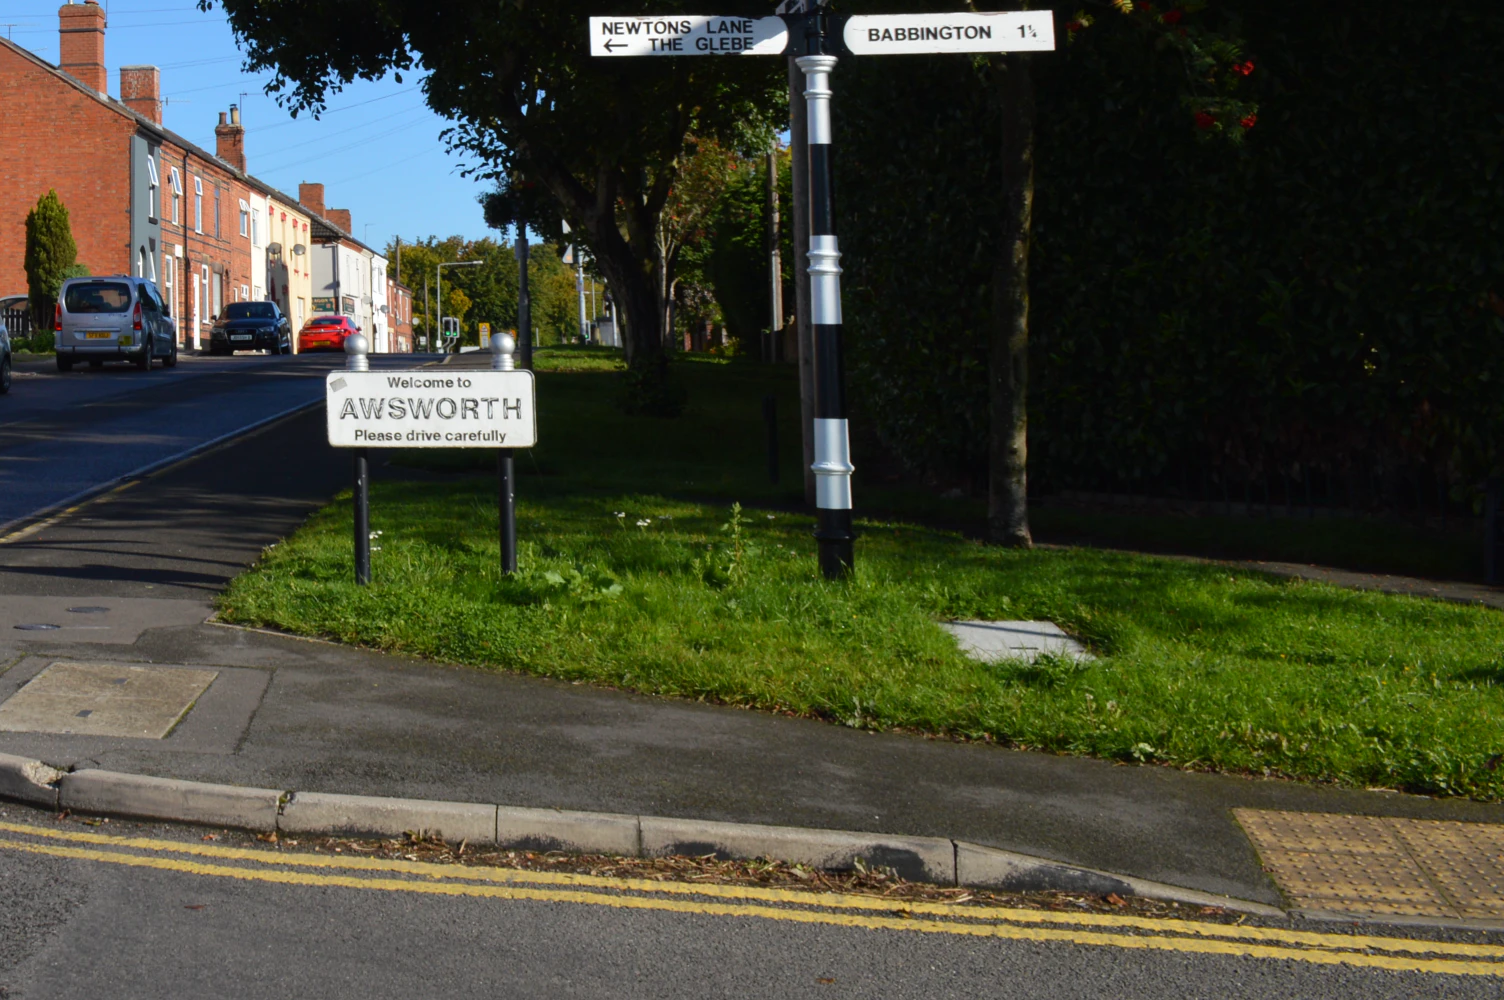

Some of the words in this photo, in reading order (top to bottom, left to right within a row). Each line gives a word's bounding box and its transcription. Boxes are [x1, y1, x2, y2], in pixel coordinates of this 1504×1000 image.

[602, 20, 692, 35] NEWTONS
[706, 20, 754, 34] LANE
[868, 25, 992, 42] BABBINGTON
[648, 37, 684, 51] THE
[696, 37, 754, 51] GLEBE
[387, 376, 454, 388] Welcome
[457, 376, 471, 388] to
[340, 398, 522, 420] AWSWORTH
[354, 429, 402, 441] Please
[406, 429, 441, 442] drive
[445, 429, 507, 444] carefully
